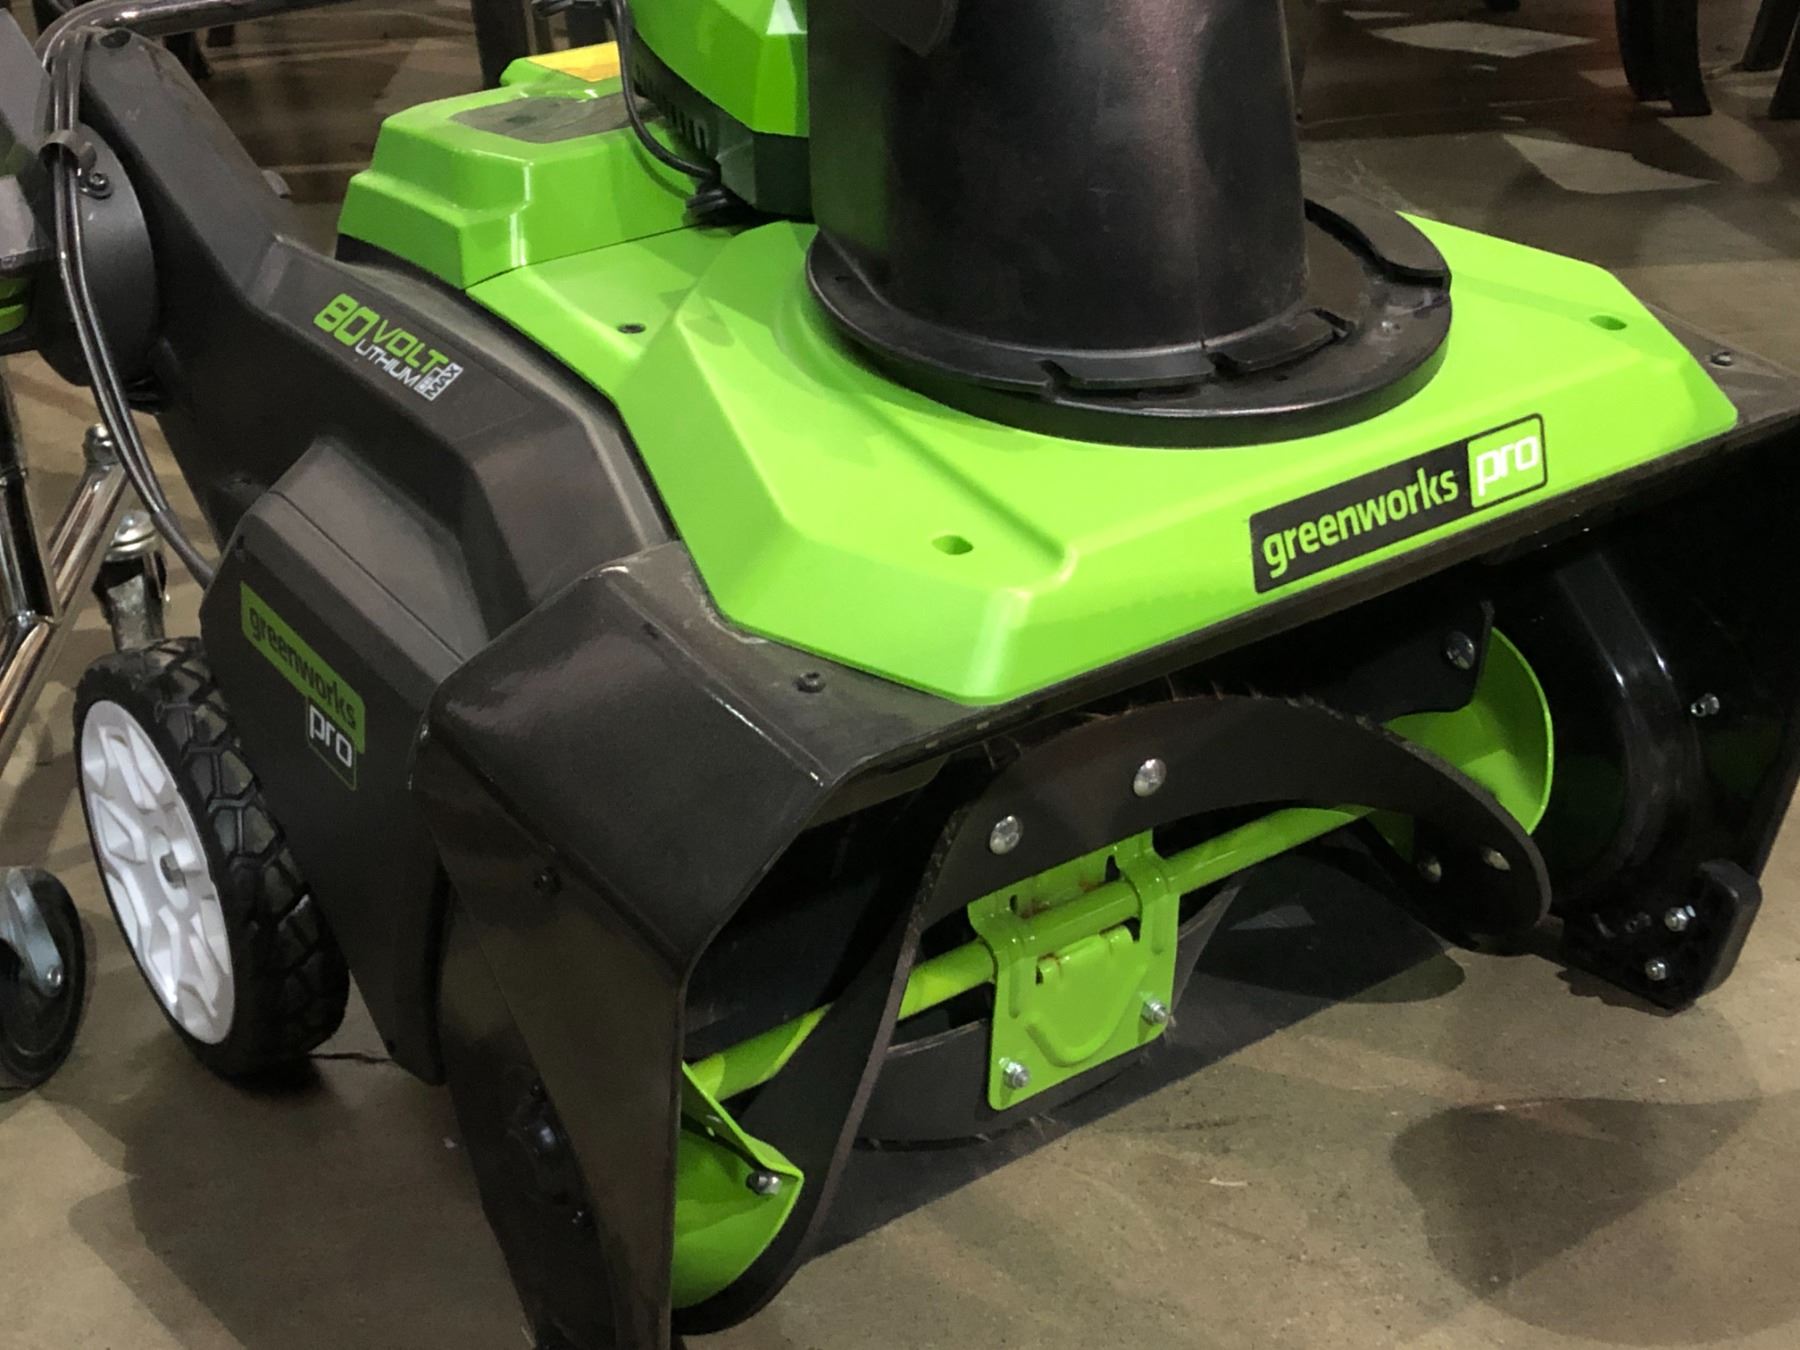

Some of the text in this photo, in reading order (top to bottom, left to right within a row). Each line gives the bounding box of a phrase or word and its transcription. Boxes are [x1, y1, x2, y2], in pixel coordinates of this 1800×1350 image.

[313, 293, 449, 375] 80 VOLT
[355, 339, 421, 388] LITHIUM
[425, 365, 459, 397] MAX
[1262, 436, 1539, 578] greenworks pro
[249, 607, 357, 730] greenworks
[310, 705, 353, 768] pro
